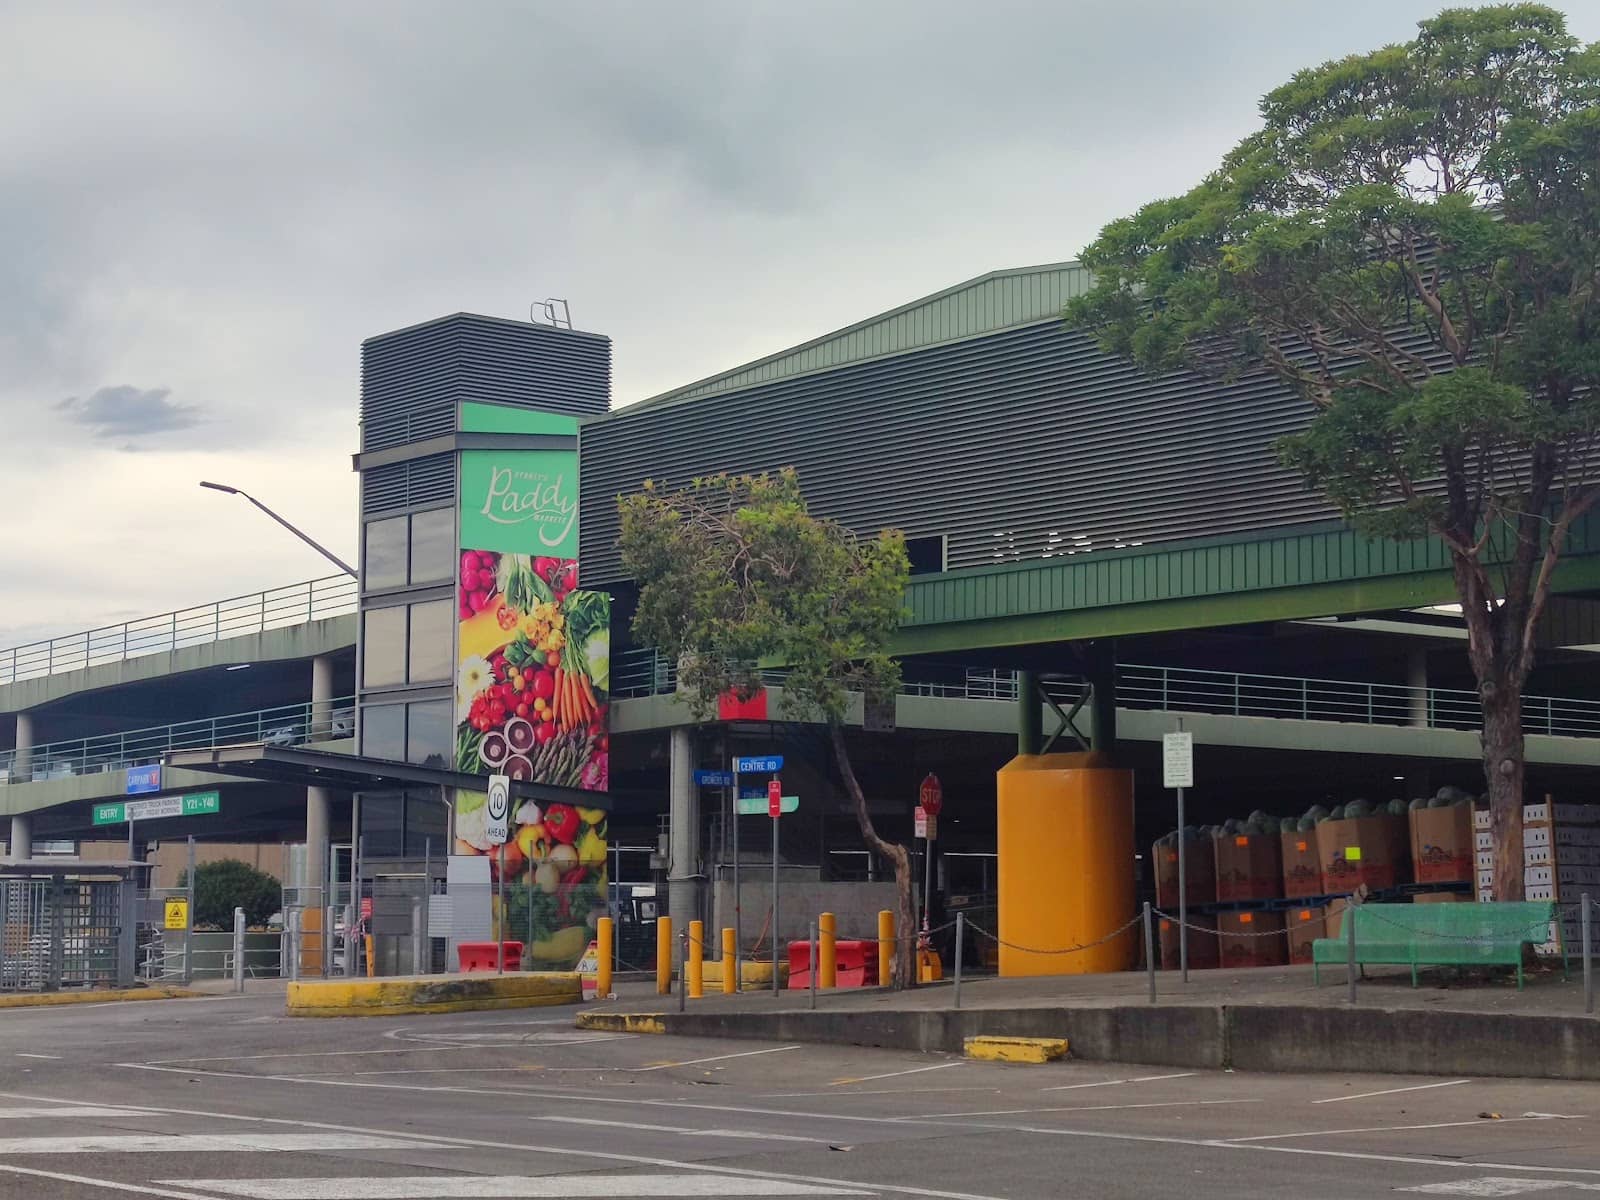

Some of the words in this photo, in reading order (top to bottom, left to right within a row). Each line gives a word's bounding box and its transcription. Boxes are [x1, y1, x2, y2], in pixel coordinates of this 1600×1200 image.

[480, 465, 577, 547] Paddy
[740, 761, 766, 771] CENTRE
[767, 760, 777, 770] RD
[128, 773, 149, 786] CARPARK
[493, 793, 503, 809] 10
[922, 788, 941, 804] STOP
[187, 799, 198, 809] Y21
[202, 797, 214, 808] Y40
[99, 808, 118, 819] ENTRY
[487, 827, 505, 838] AHEAD
